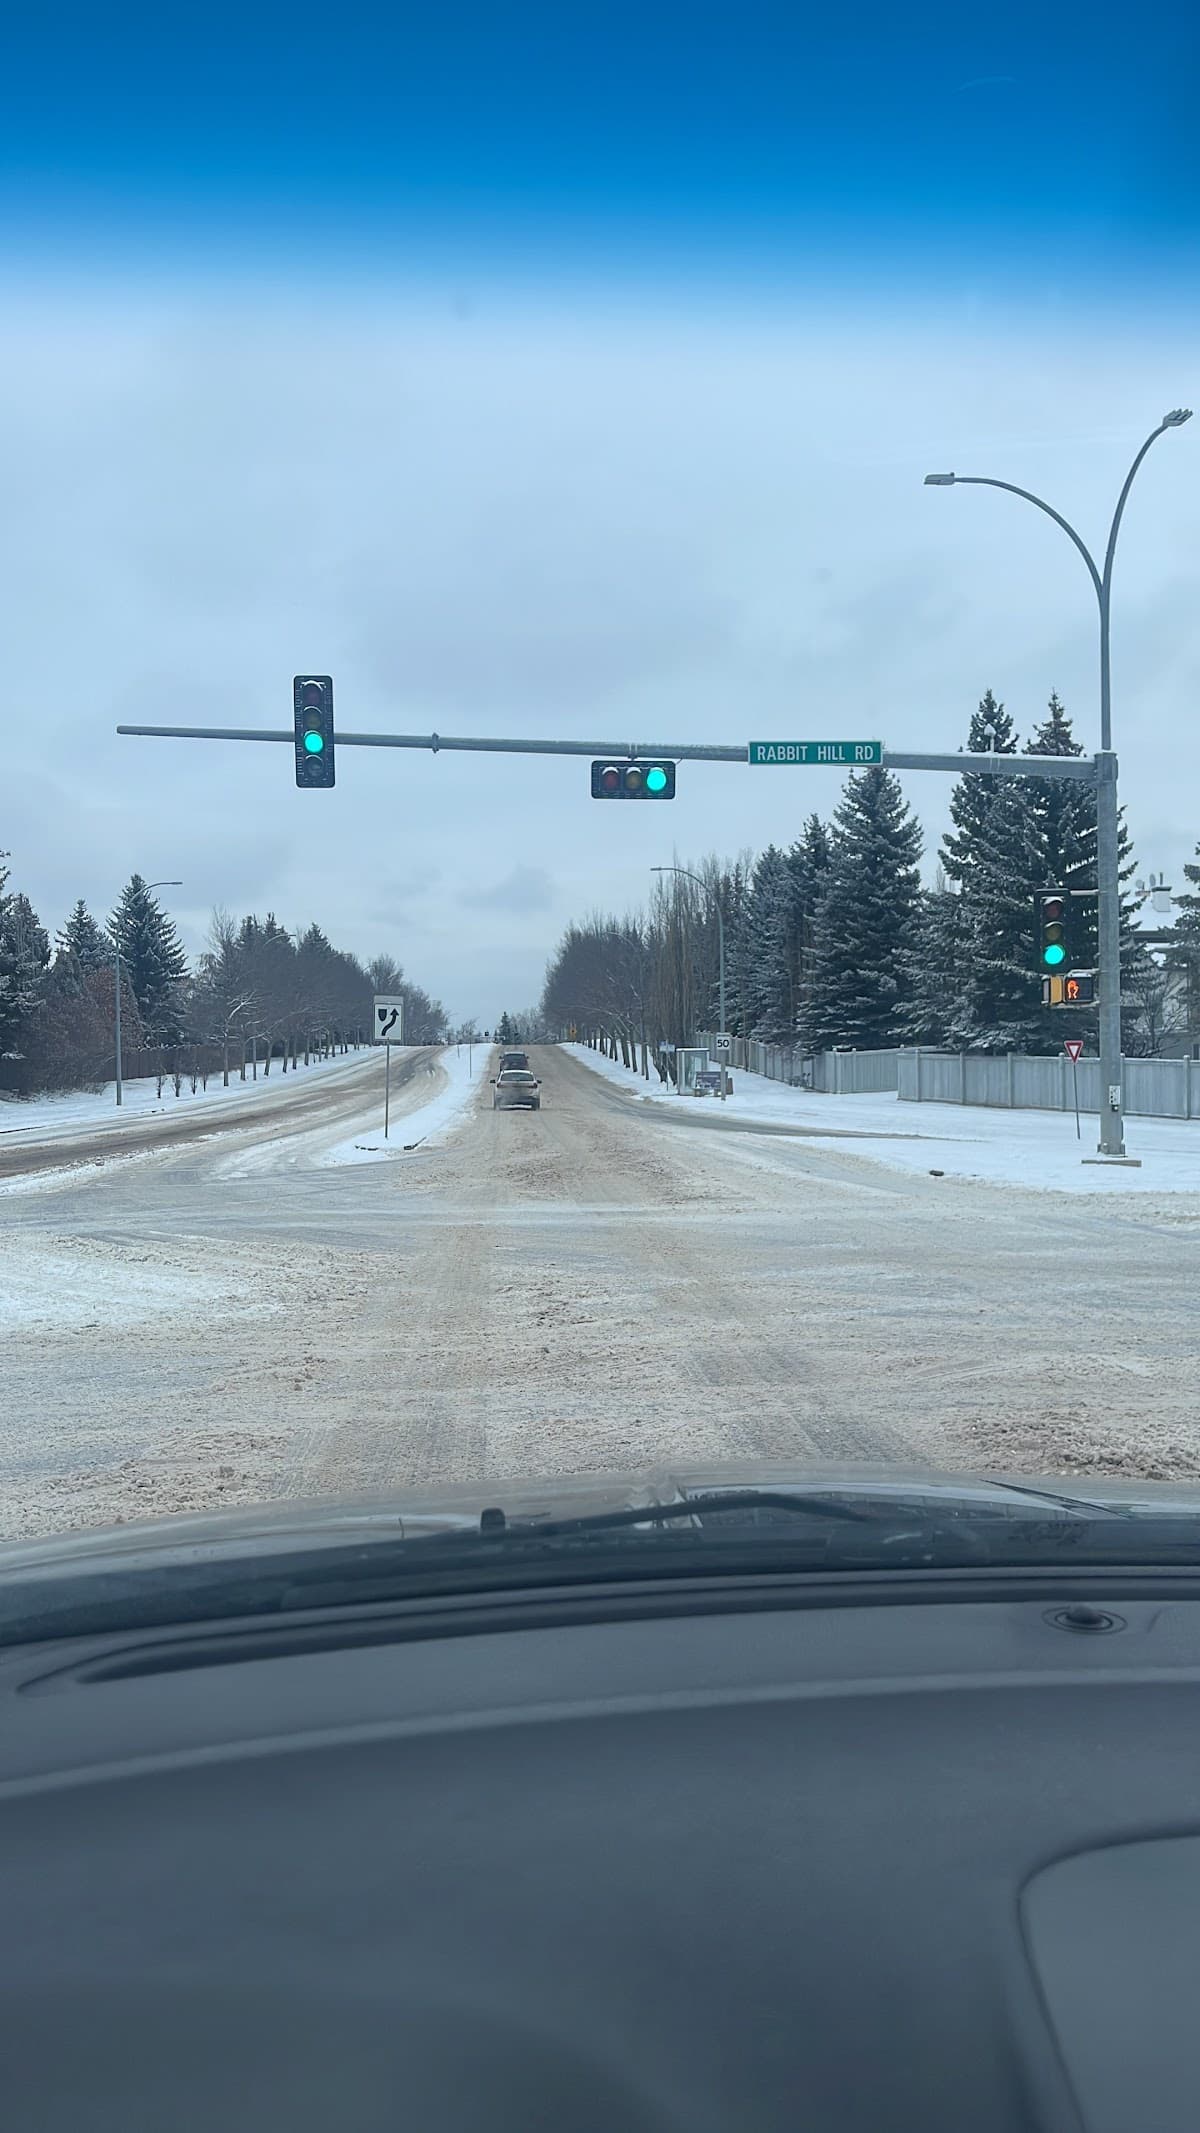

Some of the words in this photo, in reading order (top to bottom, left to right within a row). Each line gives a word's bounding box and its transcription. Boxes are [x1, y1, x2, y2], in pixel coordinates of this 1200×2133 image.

[757, 746, 808, 760] RABBIT
[817, 746, 846, 760] HILL
[855, 746, 874, 760] RD
[717, 1039, 730, 1048] 50
